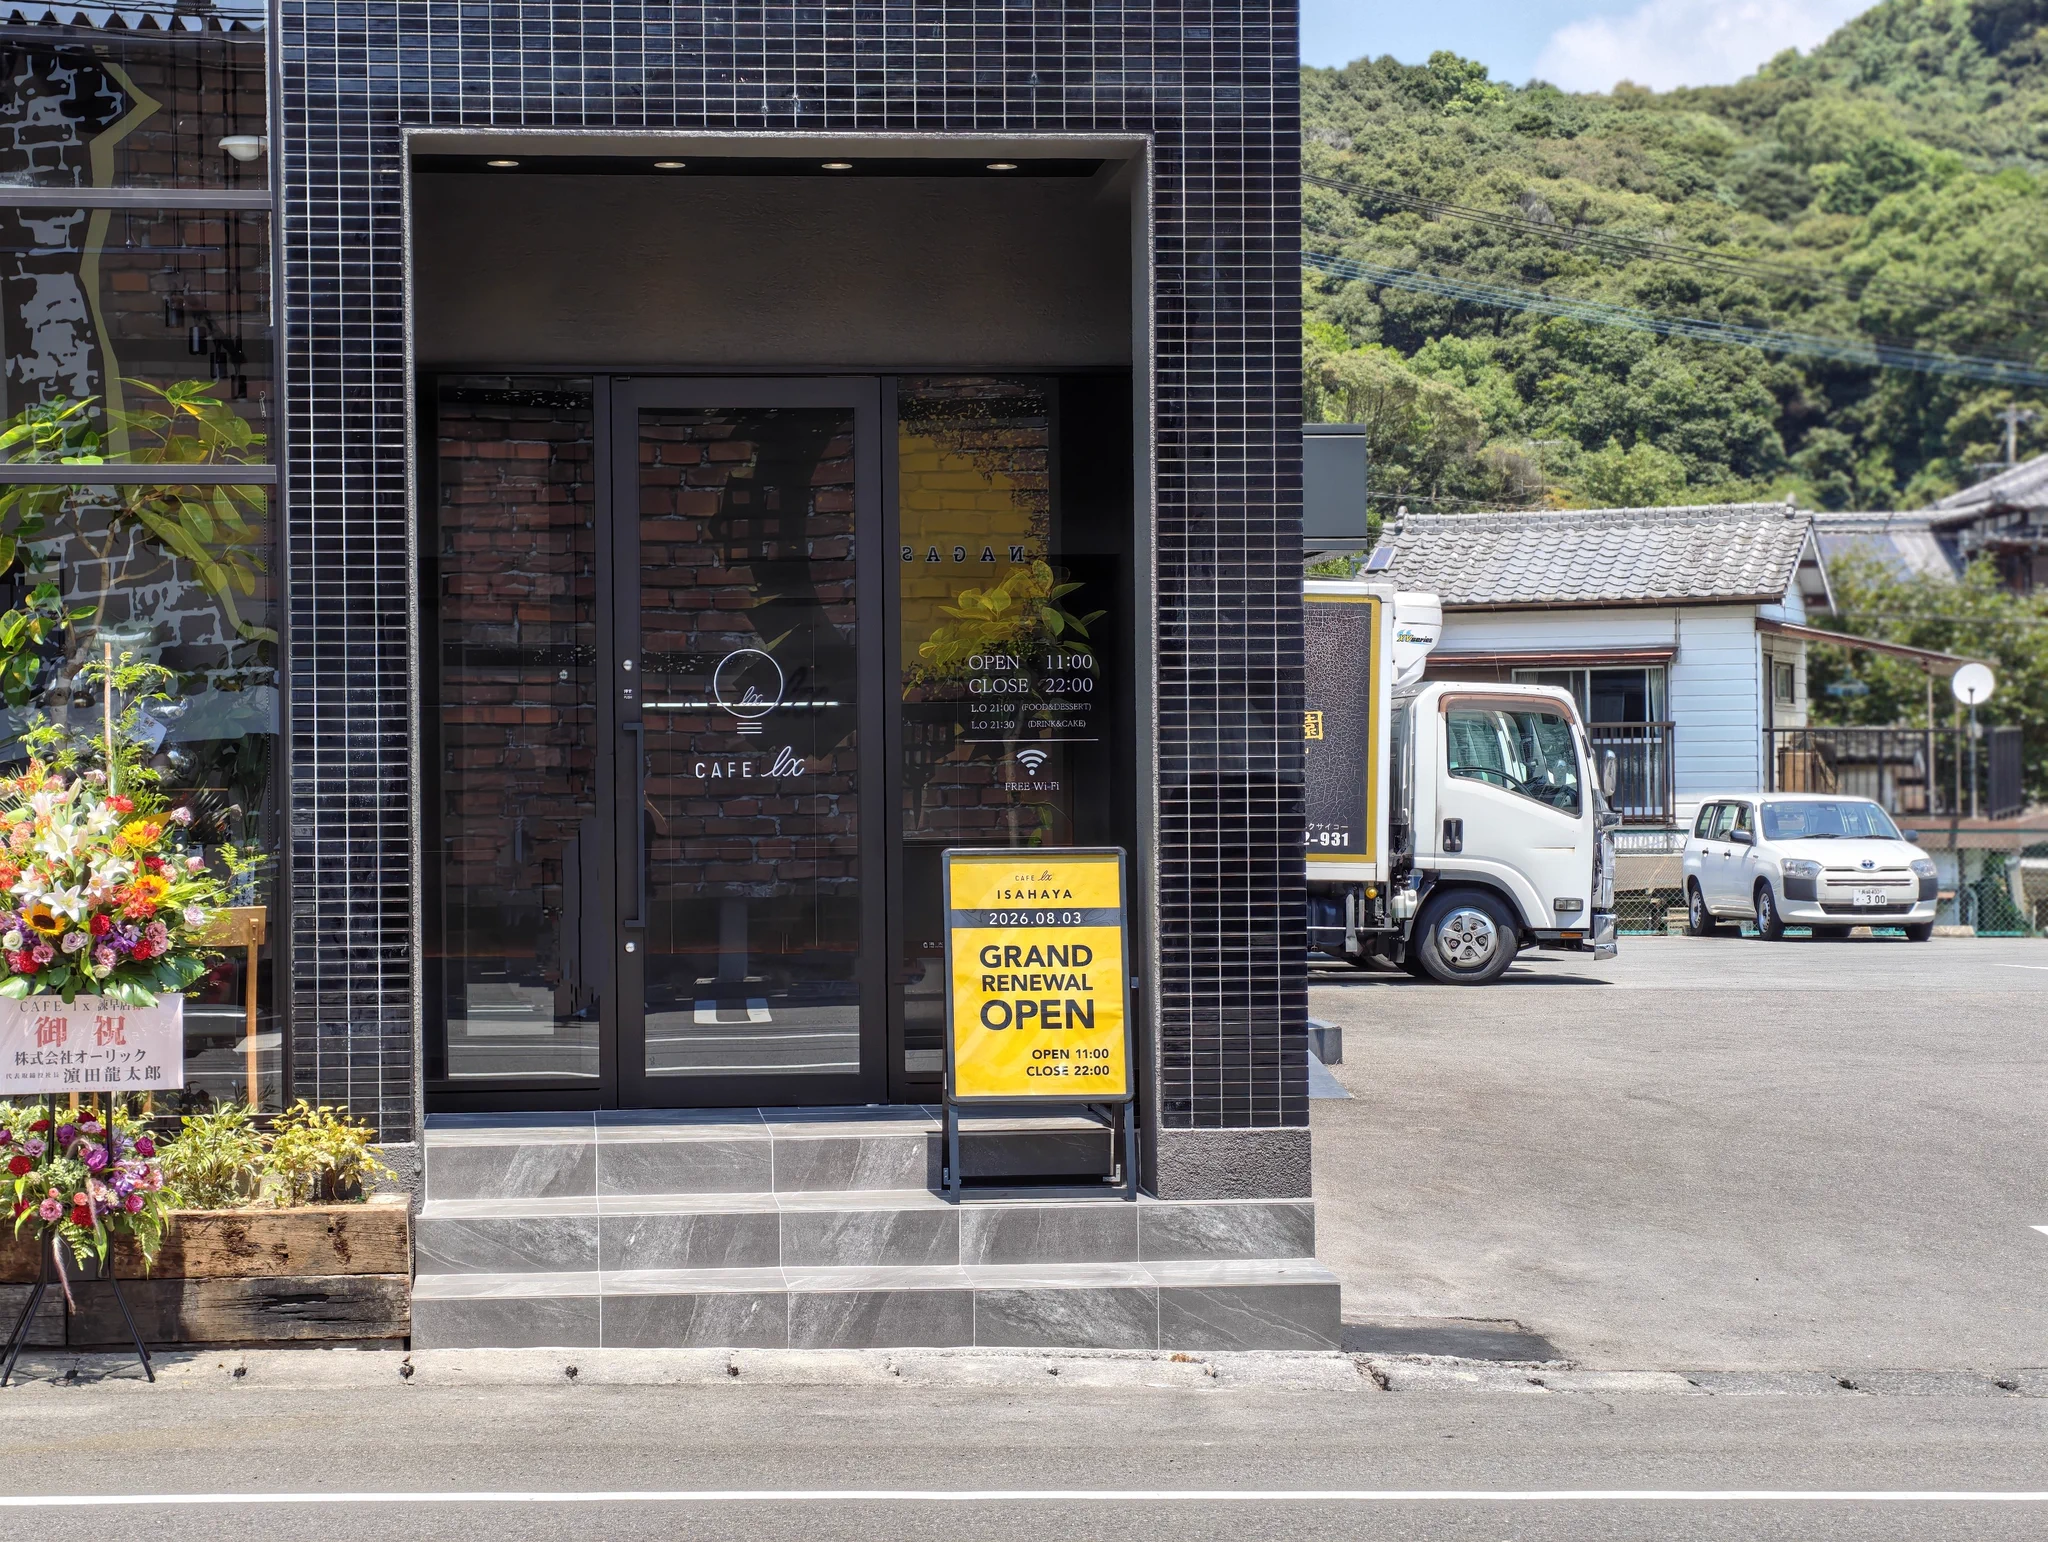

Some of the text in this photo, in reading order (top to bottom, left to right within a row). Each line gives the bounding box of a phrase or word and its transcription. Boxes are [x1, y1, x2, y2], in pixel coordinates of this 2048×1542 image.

[968, 654, 1093, 671] OPEN 11:00
[968, 677, 1093, 694] CLOSE 22:00
[990, 704, 1015, 712] 21:00
[990, 721, 1015, 729] 21:30
[695, 761, 752, 778] CAFE
[1005, 781, 1060, 791] FREE Wi-Fi
[997, 889, 1072, 900] ISAHAYA
[989, 912, 1082, 925] 2026.08.03
[980, 945, 1093, 968] GRAND
[982, 974, 1093, 992] RENEWAL
[20, 1001, 62, 1012] CAFE
[980, 999, 1095, 1031] OPEN
[15, 1049, 147, 1066] 株式会社オーリック
[1032, 1048, 1109, 1059] OPEN 11:00
[1026, 1065, 1110, 1076] CLOSE 22:00
